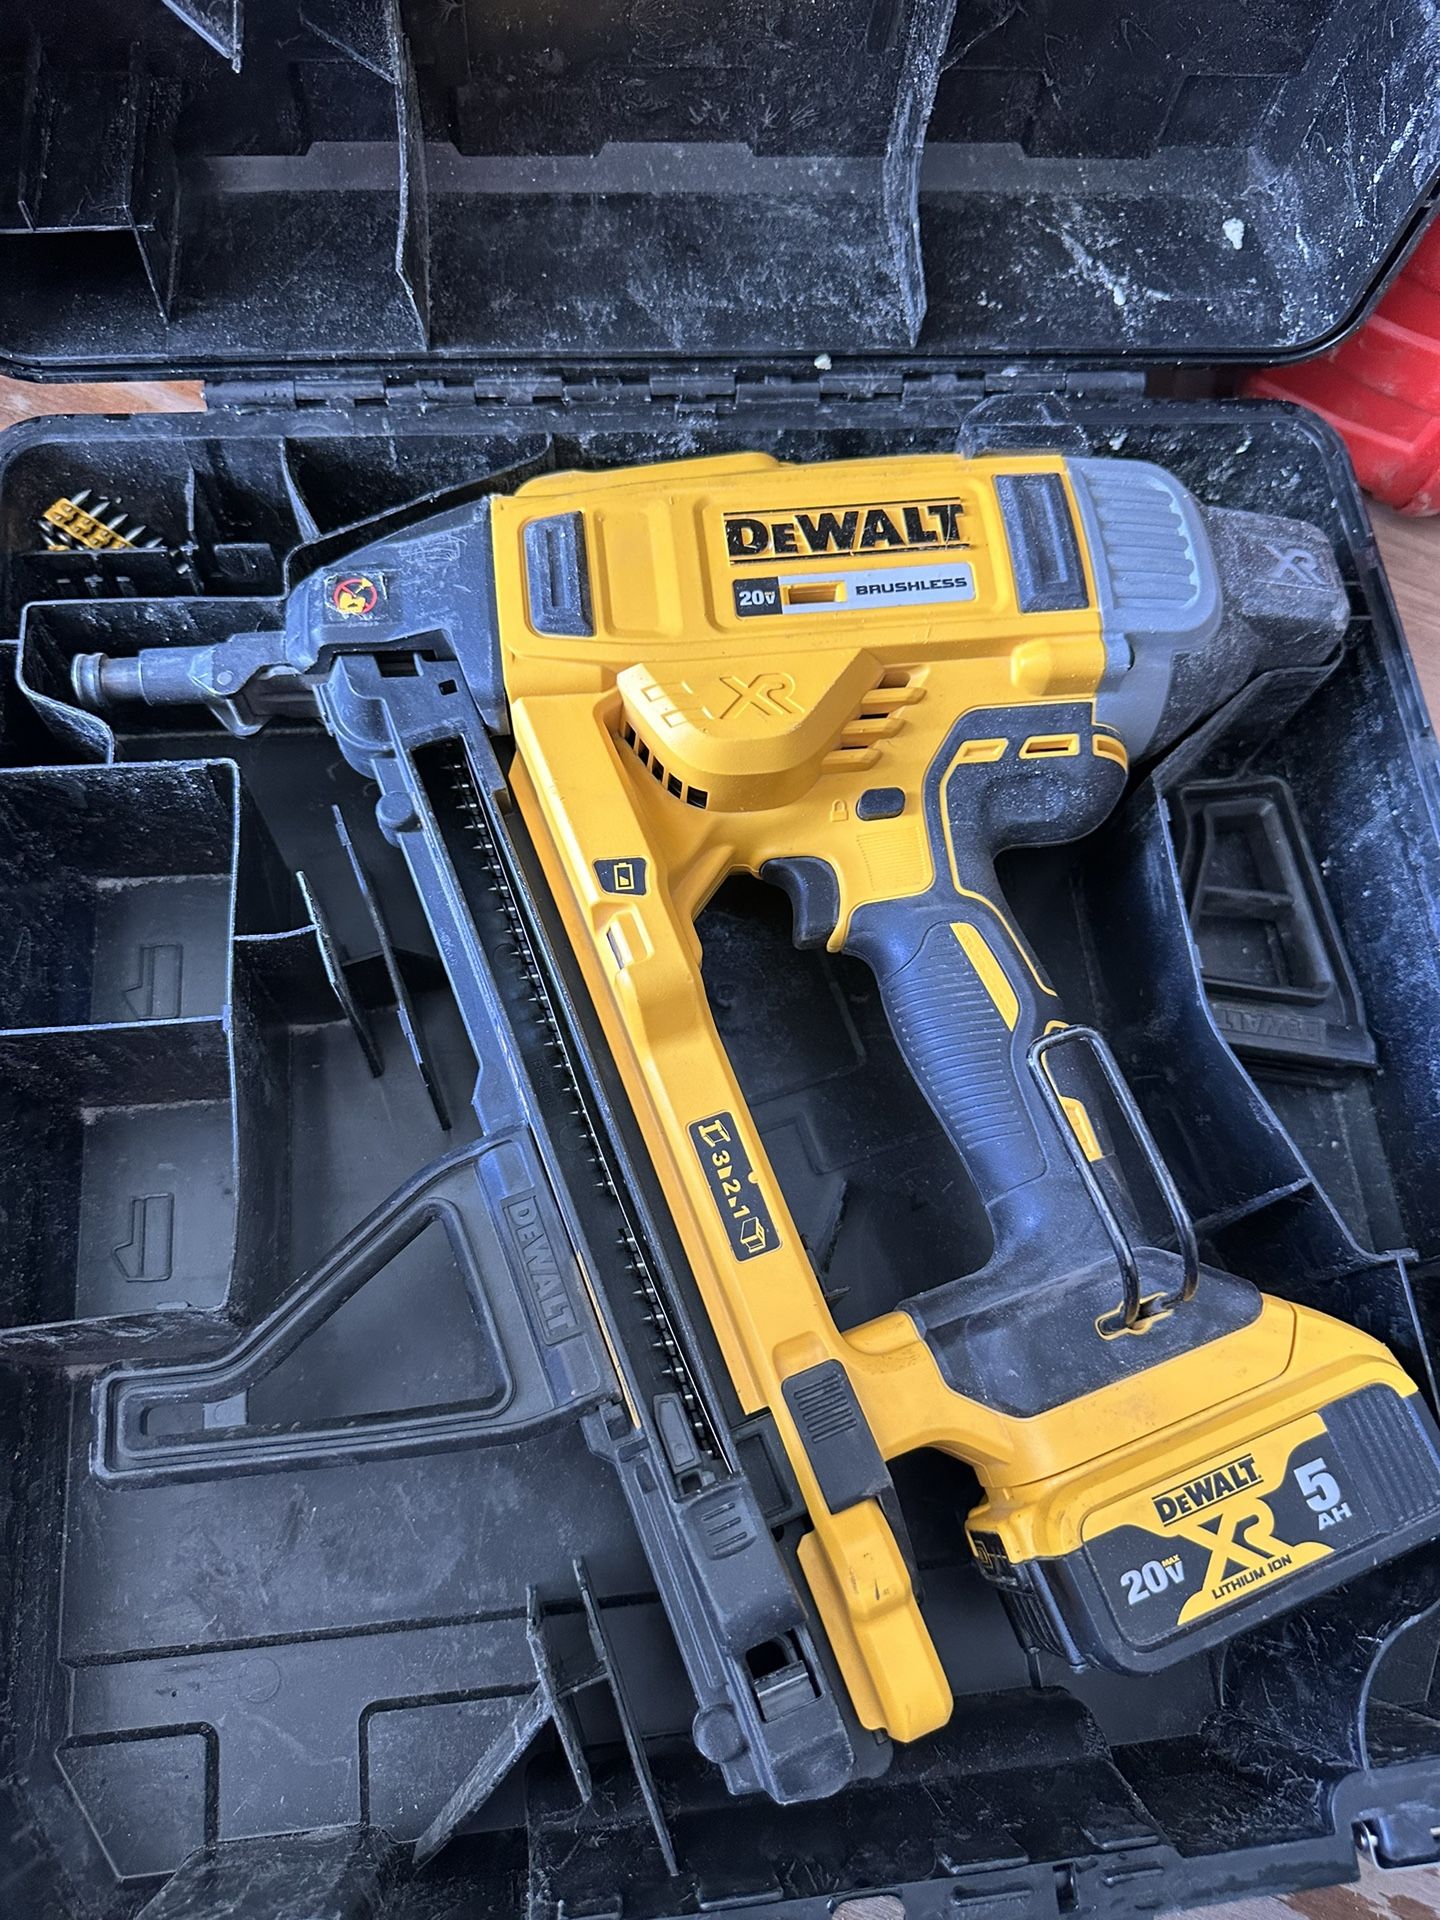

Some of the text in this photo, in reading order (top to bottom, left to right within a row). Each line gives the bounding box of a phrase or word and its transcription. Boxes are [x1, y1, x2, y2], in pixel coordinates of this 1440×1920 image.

[725, 503, 964, 556] DEWALT
[855, 577, 968, 596] BRUSHLESS
[1262, 544, 1332, 585] XR
[719, 671, 806, 720] XR
[711, 1149, 751, 1219] 3 2 1
[1152, 1456, 1263, 1525] DEWALT
[1293, 1457, 1342, 1513] 5
[1317, 1502, 1353, 1532] AH
[1178, 1497, 1297, 1592] XR
[1211, 1553, 1293, 1600] LITHIUM ION
